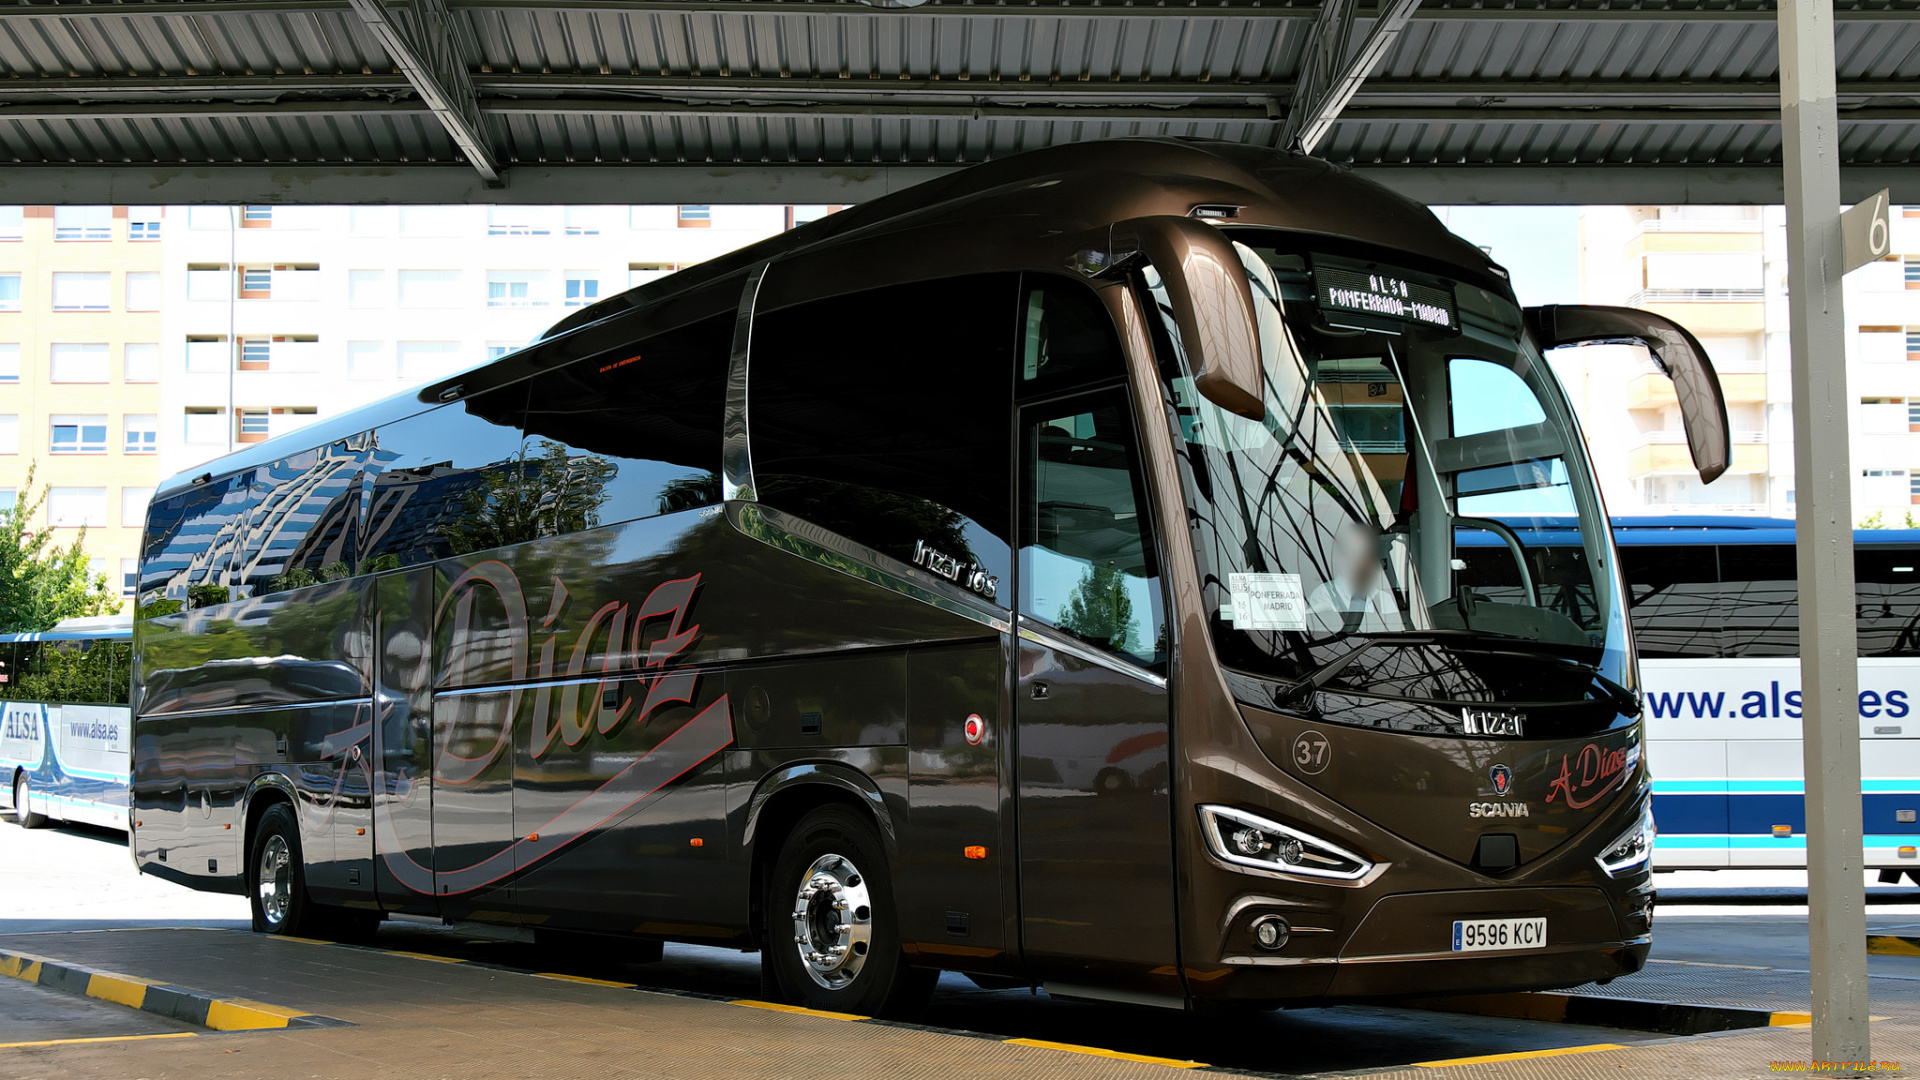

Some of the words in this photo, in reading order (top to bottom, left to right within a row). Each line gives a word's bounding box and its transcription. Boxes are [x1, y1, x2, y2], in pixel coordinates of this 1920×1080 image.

[1869, 194, 1888, 256] 6
[1369, 274, 1408, 298] ALSA
[913, 539, 967, 581] Irizar
[1232, 582, 1248, 592] BUS
[1250, 590, 1301, 600] PONFERRADA
[1239, 613, 1249, 621] 16
[1263, 602, 1293, 611] MADRID
[1643, 680, 1909, 719] ww.alses
[6, 711, 39, 741] ALSA
[70, 718, 119, 741] www.alsa.es
[1461, 706, 1526, 737] Irizar
[1296, 740, 1327, 765] 37
[1469, 802, 1530, 818] SCANIA
[1465, 924, 1508, 946] 9596
[1513, 922, 1543, 945] KCV
